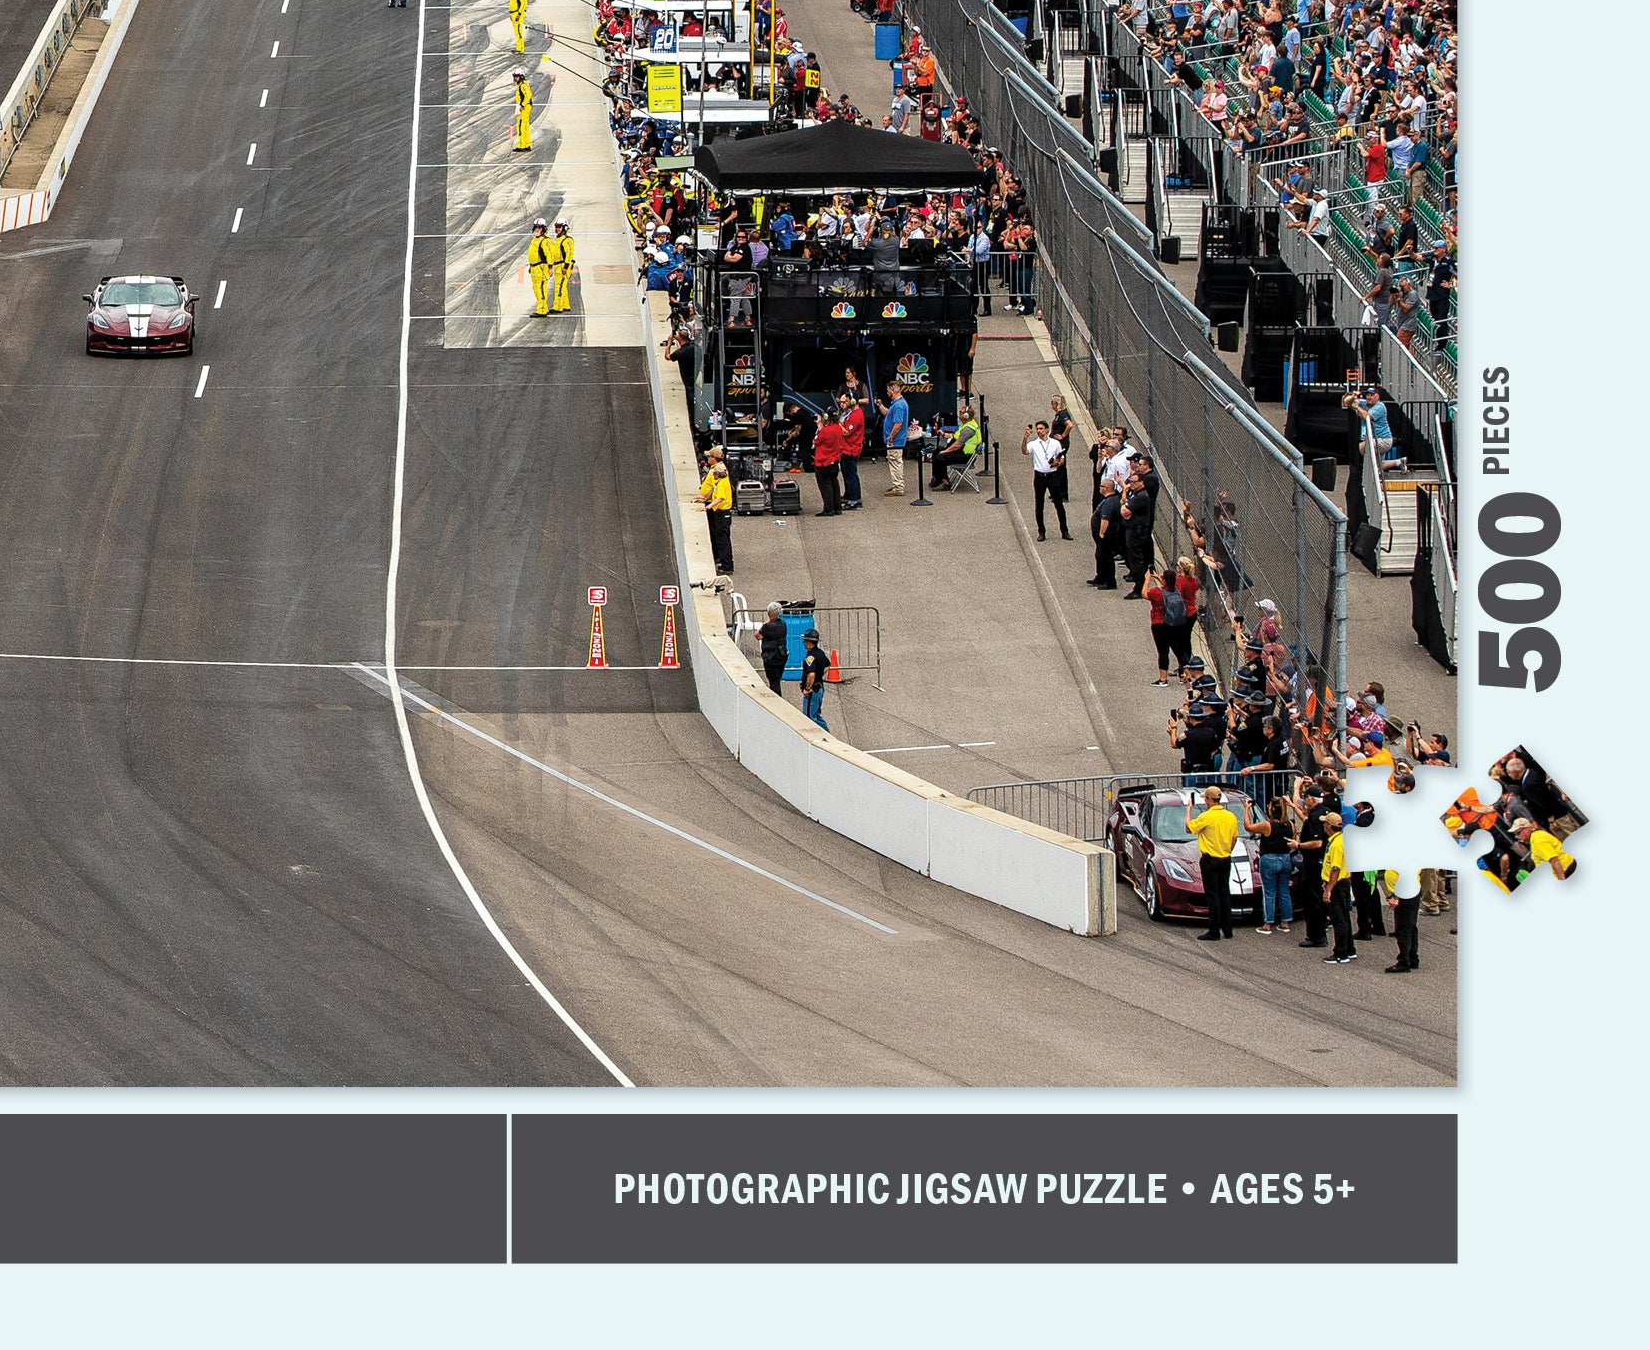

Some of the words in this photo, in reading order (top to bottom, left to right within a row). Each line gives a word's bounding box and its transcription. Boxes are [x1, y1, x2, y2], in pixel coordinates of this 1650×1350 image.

[654, 31, 673, 49] 20
[810, 71, 819, 86] 22
[731, 374, 756, 386] NB
[896, 373, 930, 386] NBC
